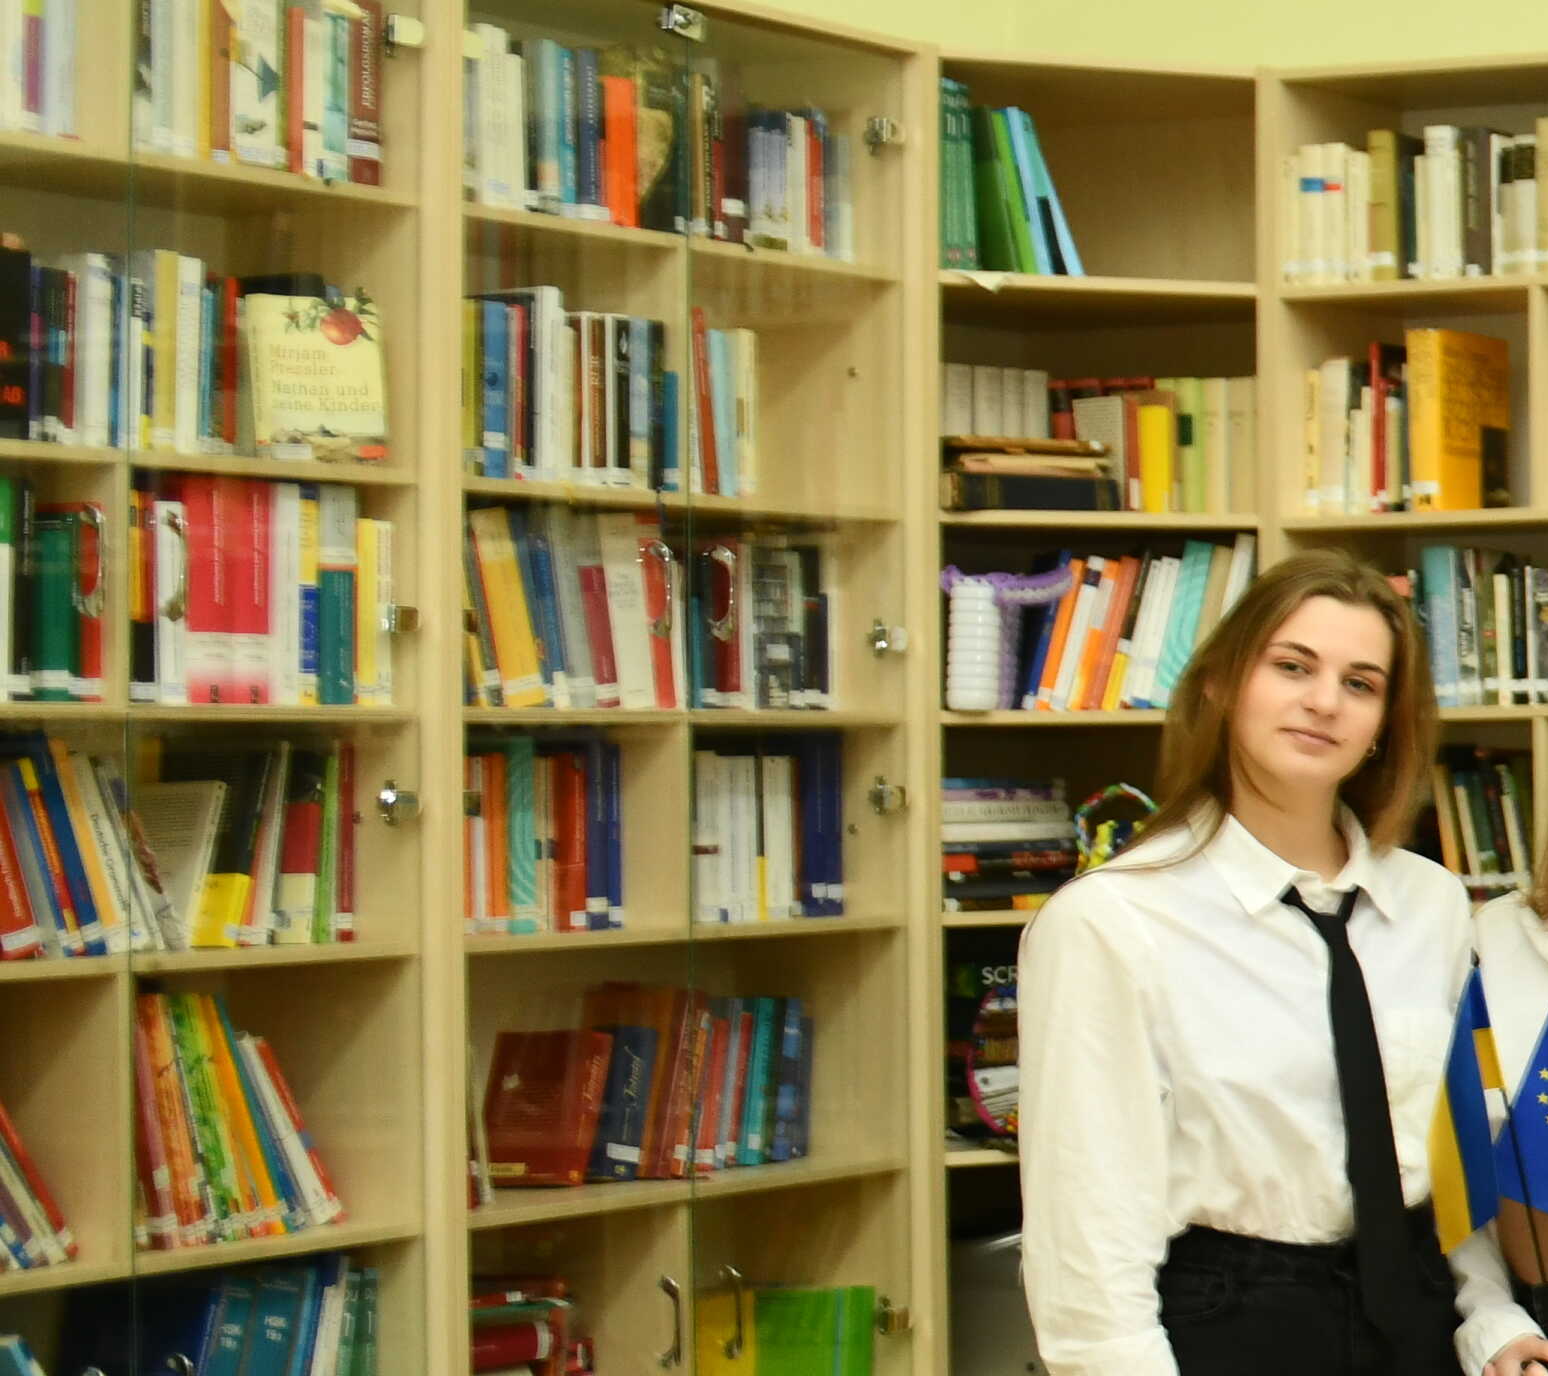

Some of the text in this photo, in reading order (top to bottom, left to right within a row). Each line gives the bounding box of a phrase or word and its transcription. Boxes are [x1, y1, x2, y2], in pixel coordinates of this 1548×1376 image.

[269, 345, 328, 364] Mirjam
[269, 360, 339, 378] Pressler
[271, 380, 370, 397] Nathan und
[318, 394, 380, 413] Kinder
